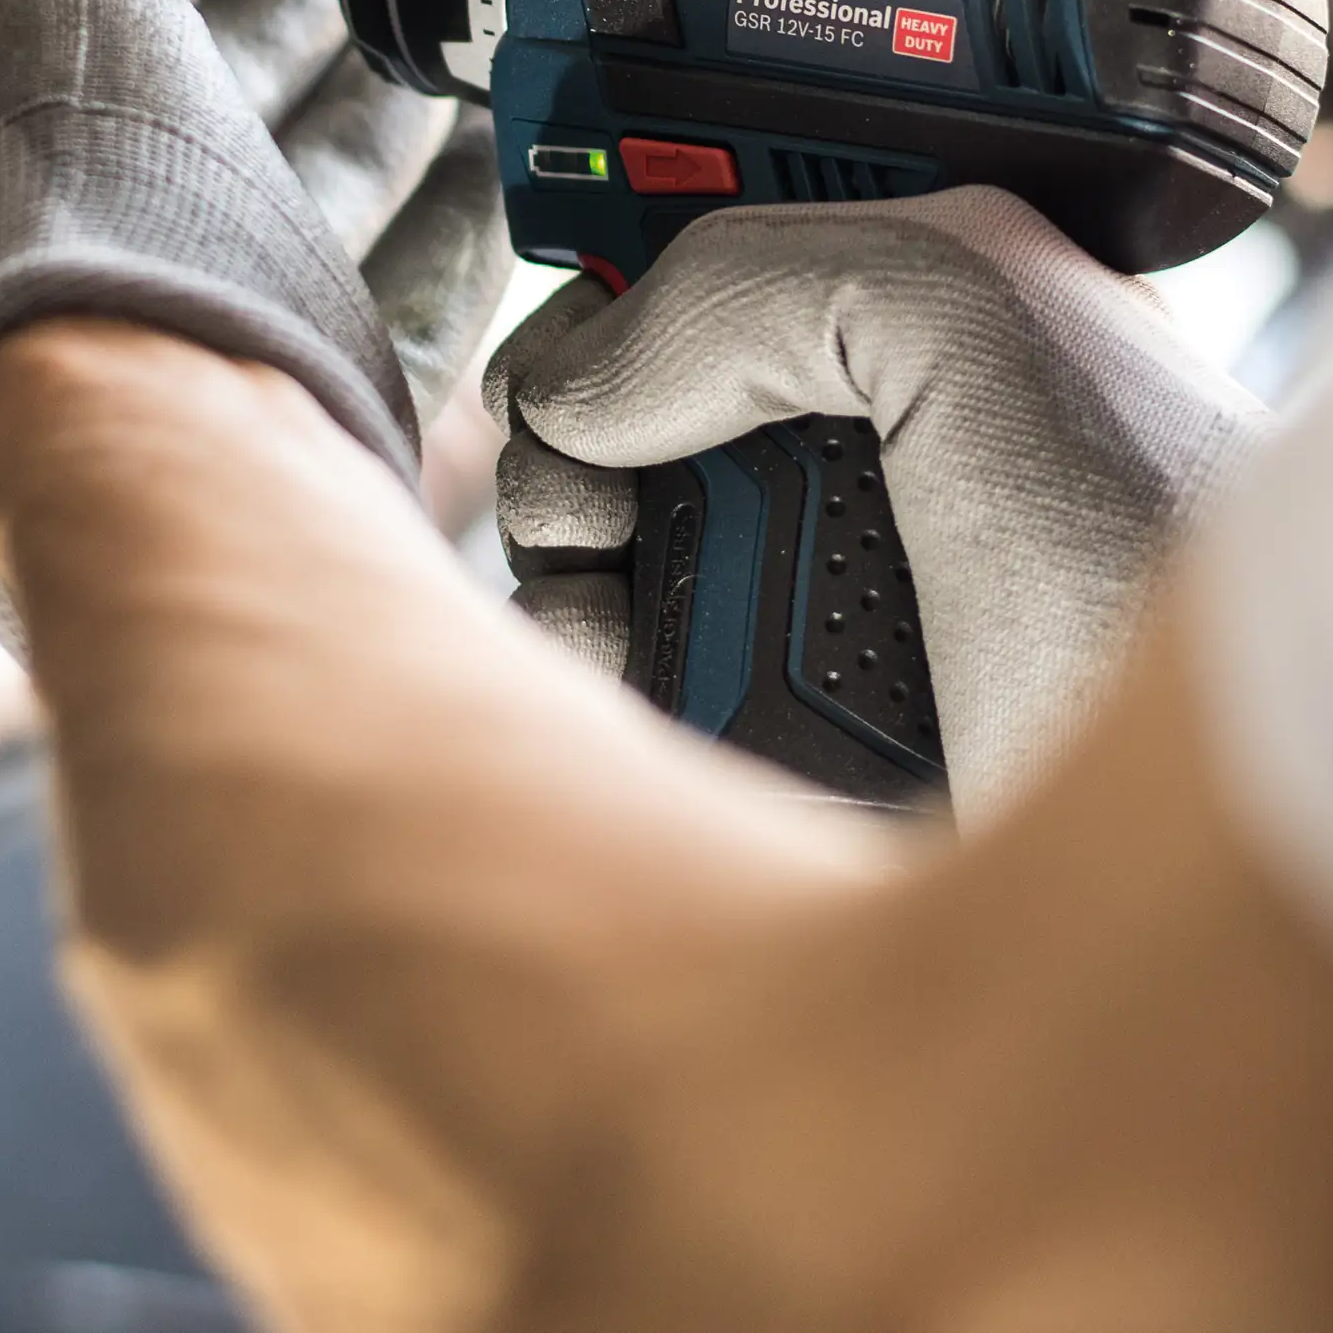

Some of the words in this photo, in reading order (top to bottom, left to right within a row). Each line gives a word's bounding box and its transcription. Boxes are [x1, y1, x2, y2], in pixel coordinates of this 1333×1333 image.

[734, 10, 771, 32] GSR
[776, 17, 835, 43] 12V-15
[840, 30, 865, 48] FC
[900, 16, 949, 37] HEAVY
[904, 35, 944, 54] DUTY
